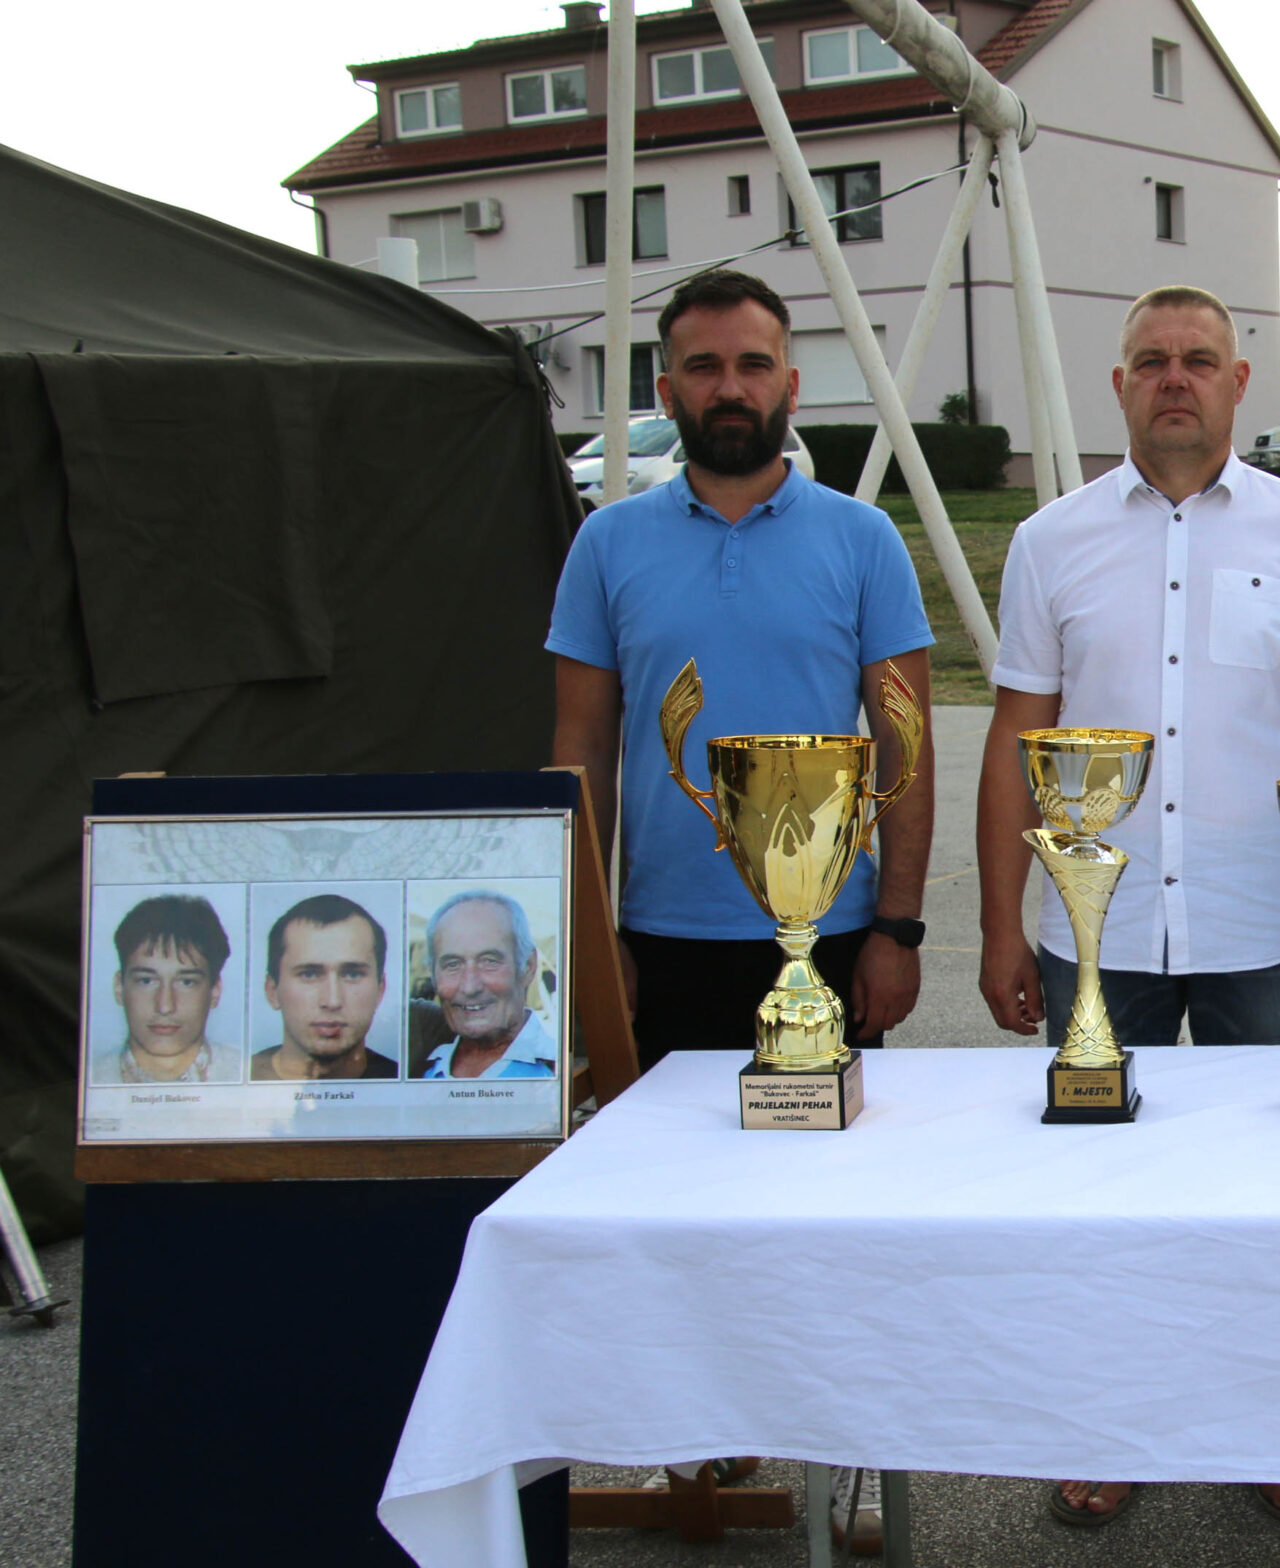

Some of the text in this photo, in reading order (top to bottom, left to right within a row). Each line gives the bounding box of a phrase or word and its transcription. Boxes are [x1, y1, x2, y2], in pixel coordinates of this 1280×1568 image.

[745, 1083, 782, 1091] Memorijalni
[1073, 1086, 1114, 1096] MJESTO
[324, 1090, 355, 1100] Farkaš
[448, 1089, 514, 1098] Antun Bukovec
[131, 1094, 200, 1105] Danijel Bukovec
[748, 1101, 832, 1110] PRIJELAZNI PEHAR
[772, 1113, 810, 1122] VRATIŠINEC
